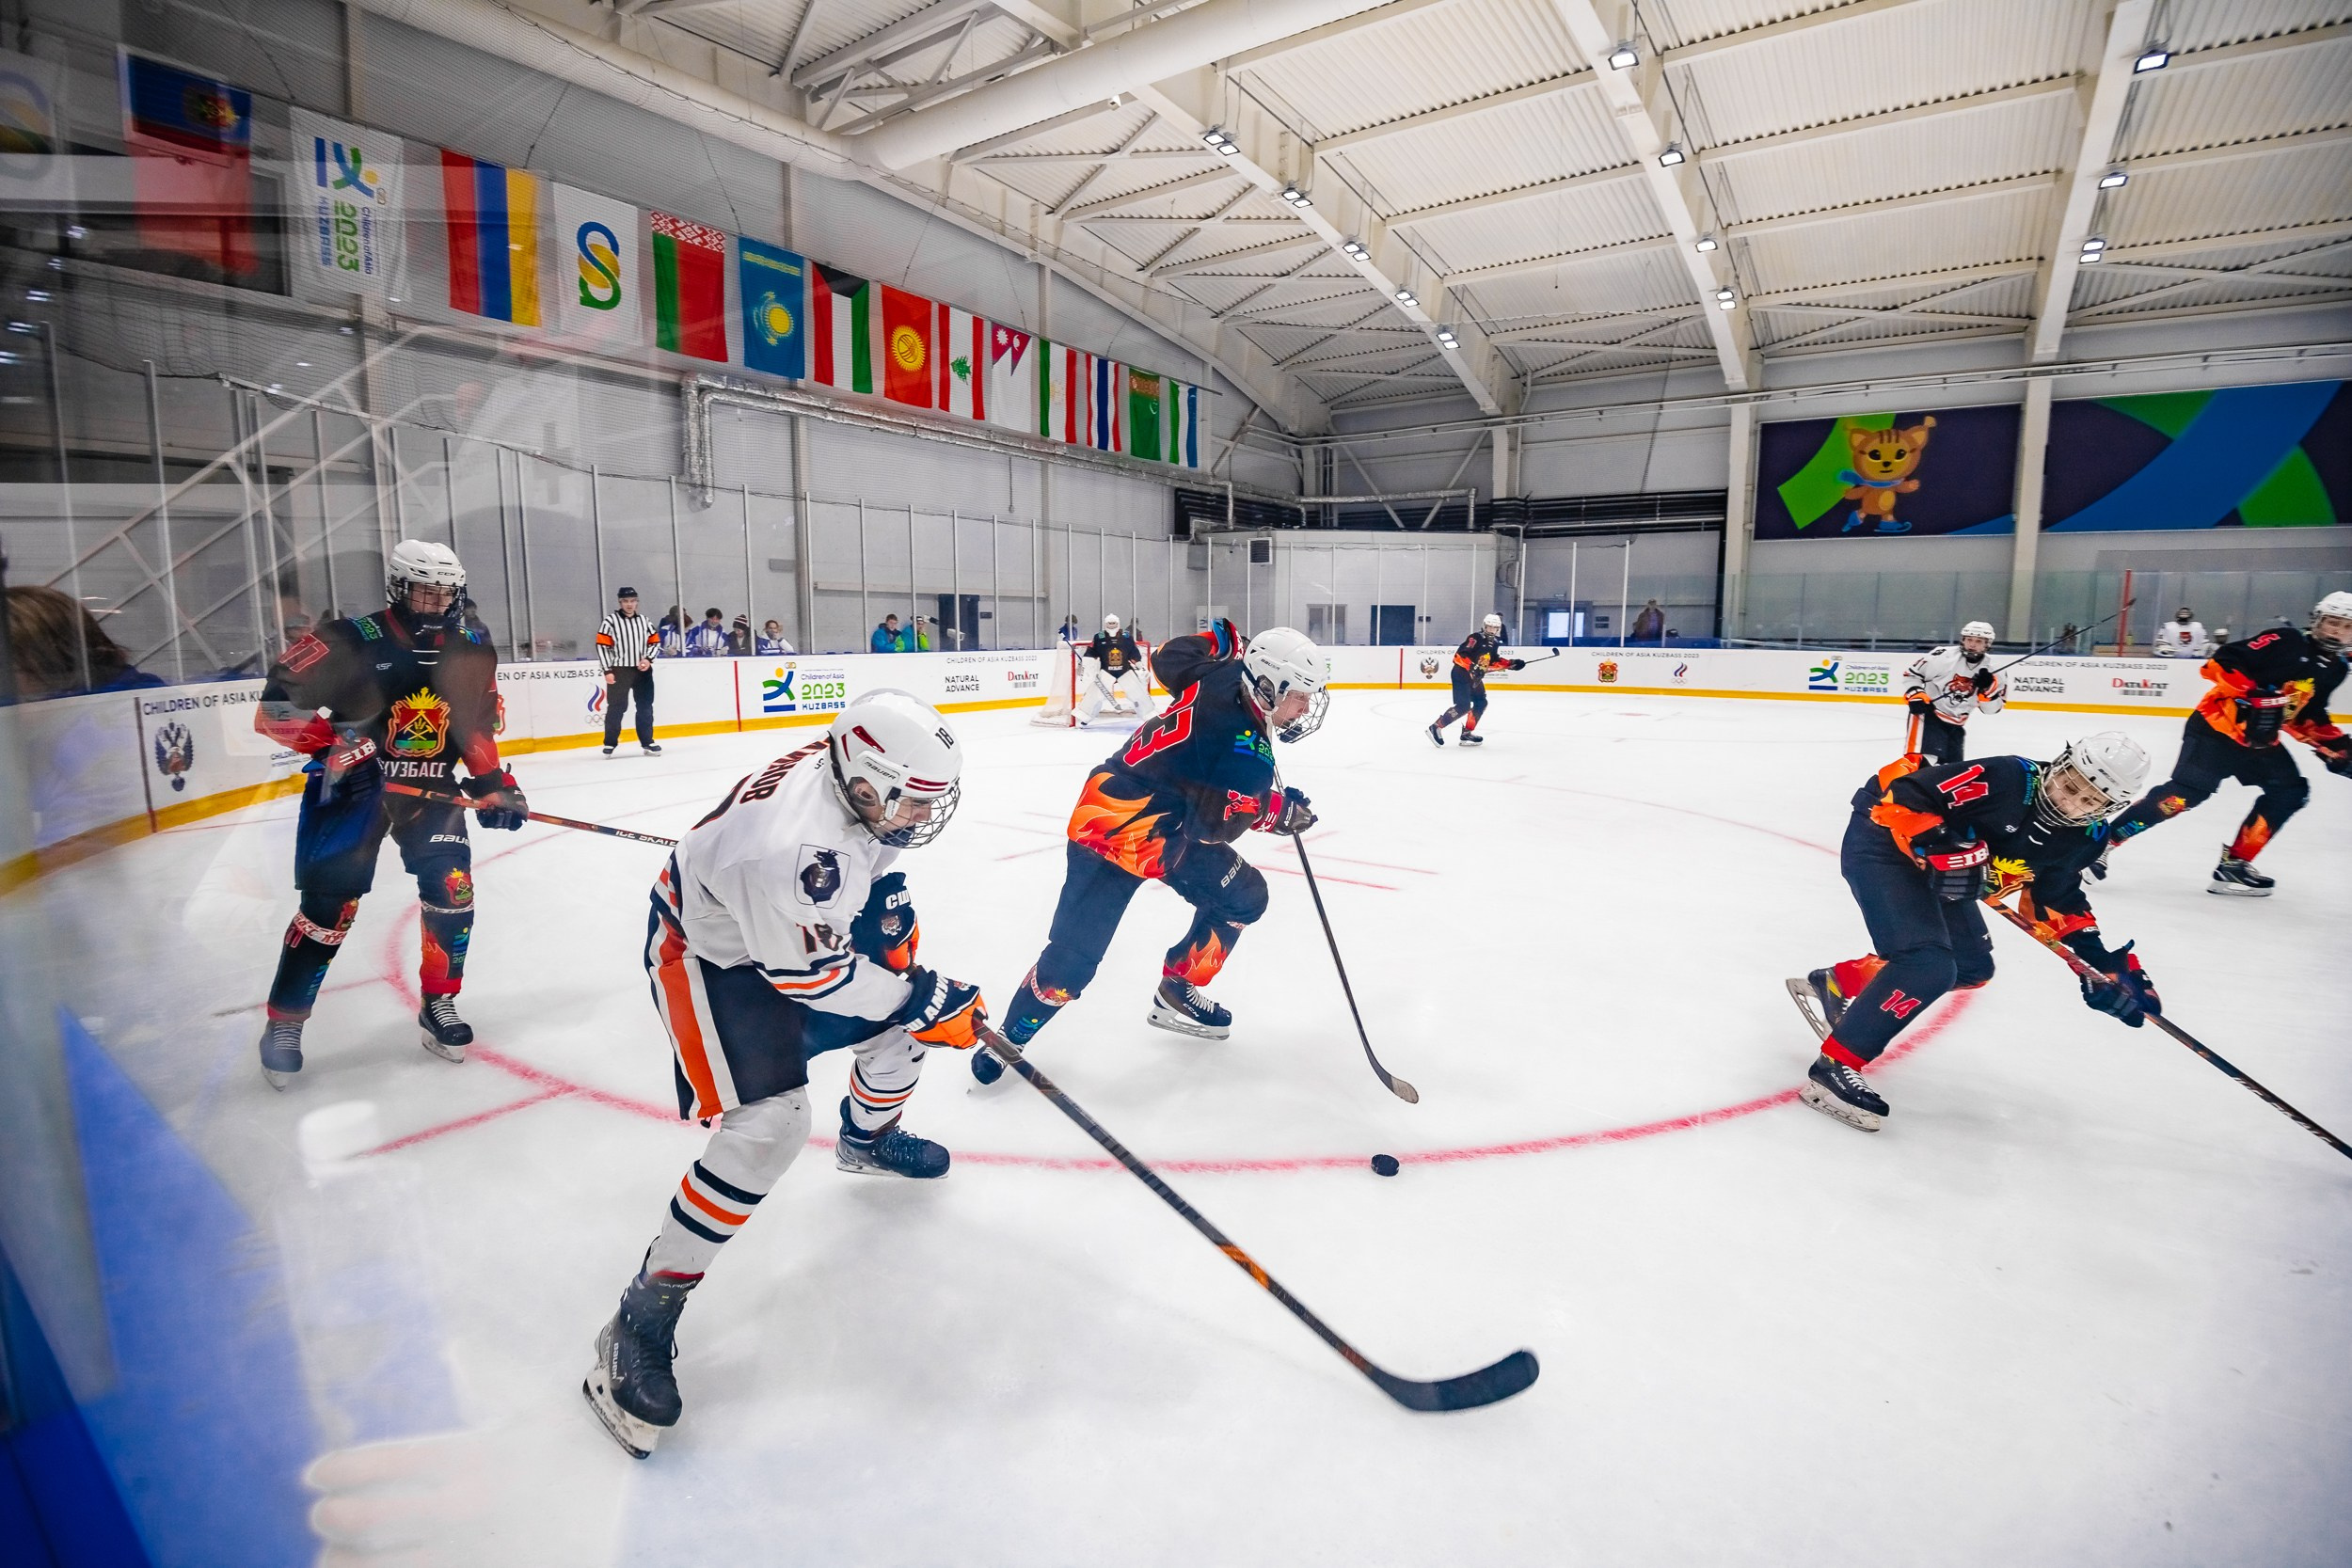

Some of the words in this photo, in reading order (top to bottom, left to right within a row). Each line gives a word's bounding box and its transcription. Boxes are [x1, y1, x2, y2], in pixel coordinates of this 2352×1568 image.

[334, 200, 359, 272] 2023
[2247, 633, 2280, 650] 5
[513, 672, 528, 681] OF
[530, 671, 550, 680] ASIA
[554, 669, 595, 679] KUZBASS
[945, 675, 979, 684] NATURAL
[1845, 673, 1889, 685] 2023
[2014, 676, 2065, 686] NATURAL
[802, 683, 845, 700] 2023
[946, 684, 979, 693] ADVANCE
[2014, 685, 2065, 693] ADVANCE
[143, 697, 200, 716] CHILDREN
[202, 695, 219, 708] OF
[222, 691, 247, 705] ASIA
[803, 702, 846, 710] KUZBASS
[934, 726, 955, 750] 18
[1182, 1003, 1200, 1018] CCM
[1880, 990, 1922, 1020] 14
[612, 1342, 620, 1380] BAUER
